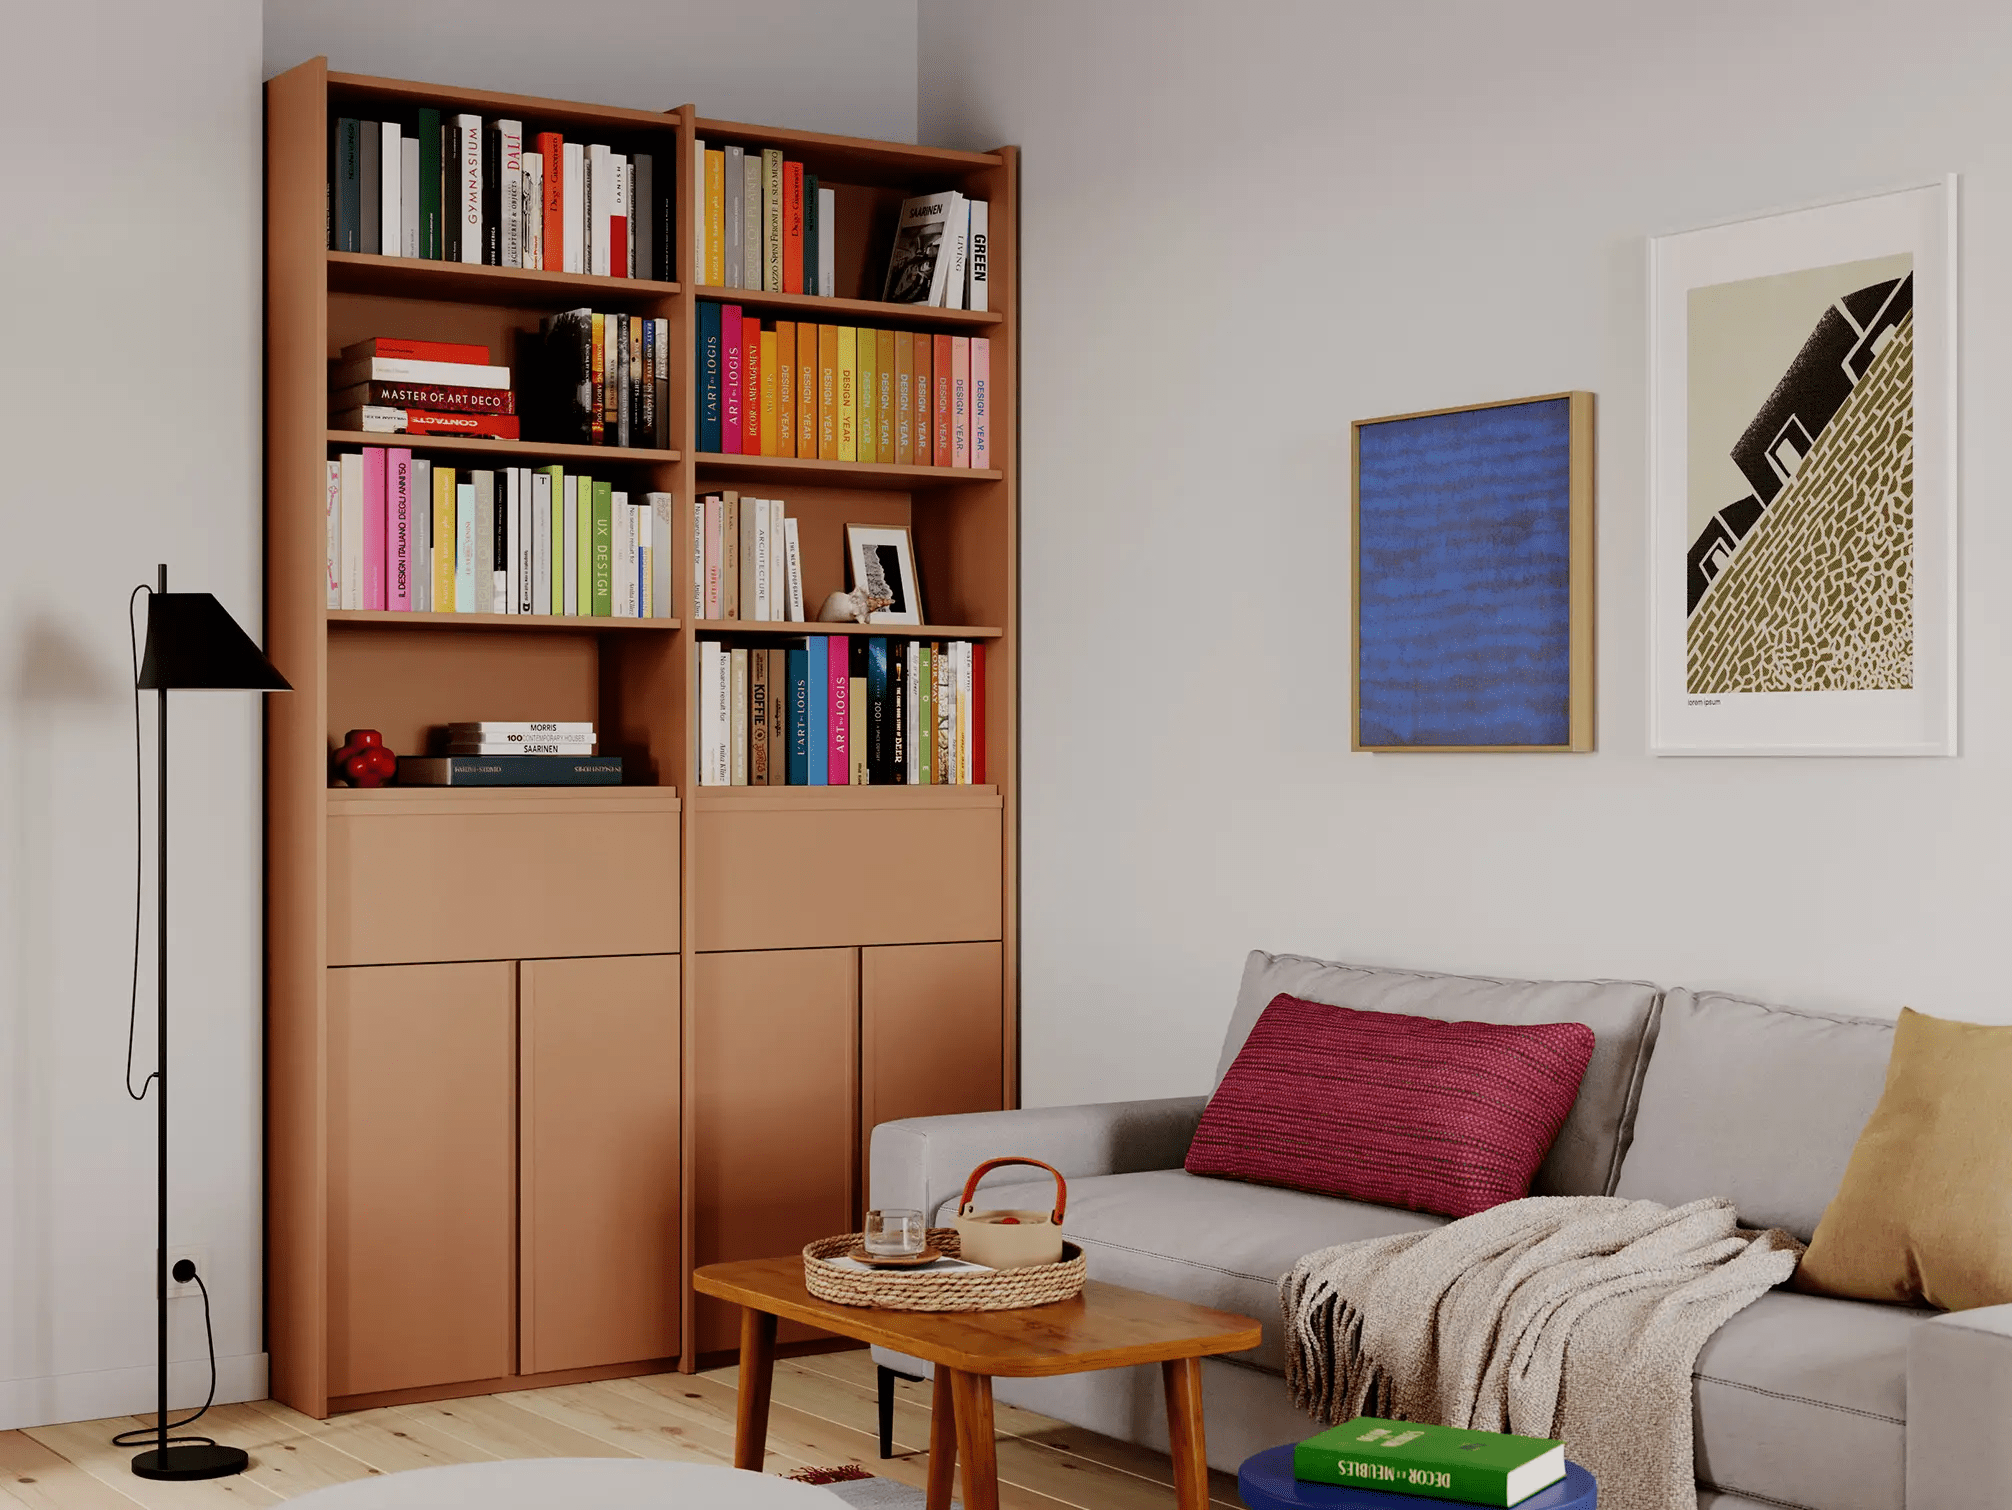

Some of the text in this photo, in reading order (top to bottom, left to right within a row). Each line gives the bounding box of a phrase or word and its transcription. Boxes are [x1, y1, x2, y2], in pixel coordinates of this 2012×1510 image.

[504, 134, 520, 171] DALÍ
[771, 151, 779, 178] MUSEO
[468, 128, 477, 224] GYMNASIUM
[771, 179, 779, 195] SUO
[550, 186, 559, 212] Diego
[791, 164, 800, 237] Diego Giacometti
[909, 203, 943, 219] SAARINEN
[748, 224, 757, 240] OF
[770, 244, 779, 264] SPINI
[955, 235, 964, 272] LIVING
[973, 233, 987, 282] GREEN
[771, 266, 779, 293] LAZZO
[707, 336, 717, 421] L'ART LOGIS
[728, 347, 738, 425] ART LOGIS
[381, 389, 427, 402] MASTER
[429, 392, 445, 403] OF
[447, 393, 469, 404] ART
[471, 395, 501, 407] DECO
[781, 365, 790, 439] DESIGN YEAR
[803, 366, 811, 440] DESIGN YEAR
[824, 368, 832, 442] DESIGN YEAR
[842, 369, 851, 442] DESIGN YEAR
[863, 370, 871, 444] DESIGN YEAR
[881, 372, 889, 445] DESIGN YEAR
[900, 374, 908, 446] DESIGN YEAR
[918, 375, 926, 448] DESIGN YEAR
[749, 410, 757, 436] DECOR
[956, 379, 964, 450] DESIGN YEAR
[977, 380, 985, 451] DESIGN YEAR
[398, 475, 406, 497] ANNI
[540, 477, 547, 485] T
[398, 497, 406, 520] DEGLI
[630, 507, 635, 516] No
[694, 506, 701, 515] No
[398, 522, 406, 558] ITALIANO
[597, 519, 608, 596] UX DESIGN
[398, 559, 406, 590] DESIGN
[523, 603, 530, 612] D
[719, 655, 726, 666] No
[754, 684, 765, 726] KOFFIE
[836, 676, 845, 715] LOGIS
[1687, 698, 1721, 708] lorem ipsum
[797, 679, 805, 755] L'ART LOGIS
[874, 701, 882, 722] 2001
[523, 745, 558, 753] SAARINEN
[836, 725, 845, 753] ART
[894, 737, 902, 763] BEER
[1338, 1460, 1394, 1482] MEUBLES
[1408, 1468, 1451, 1489] DECOR
